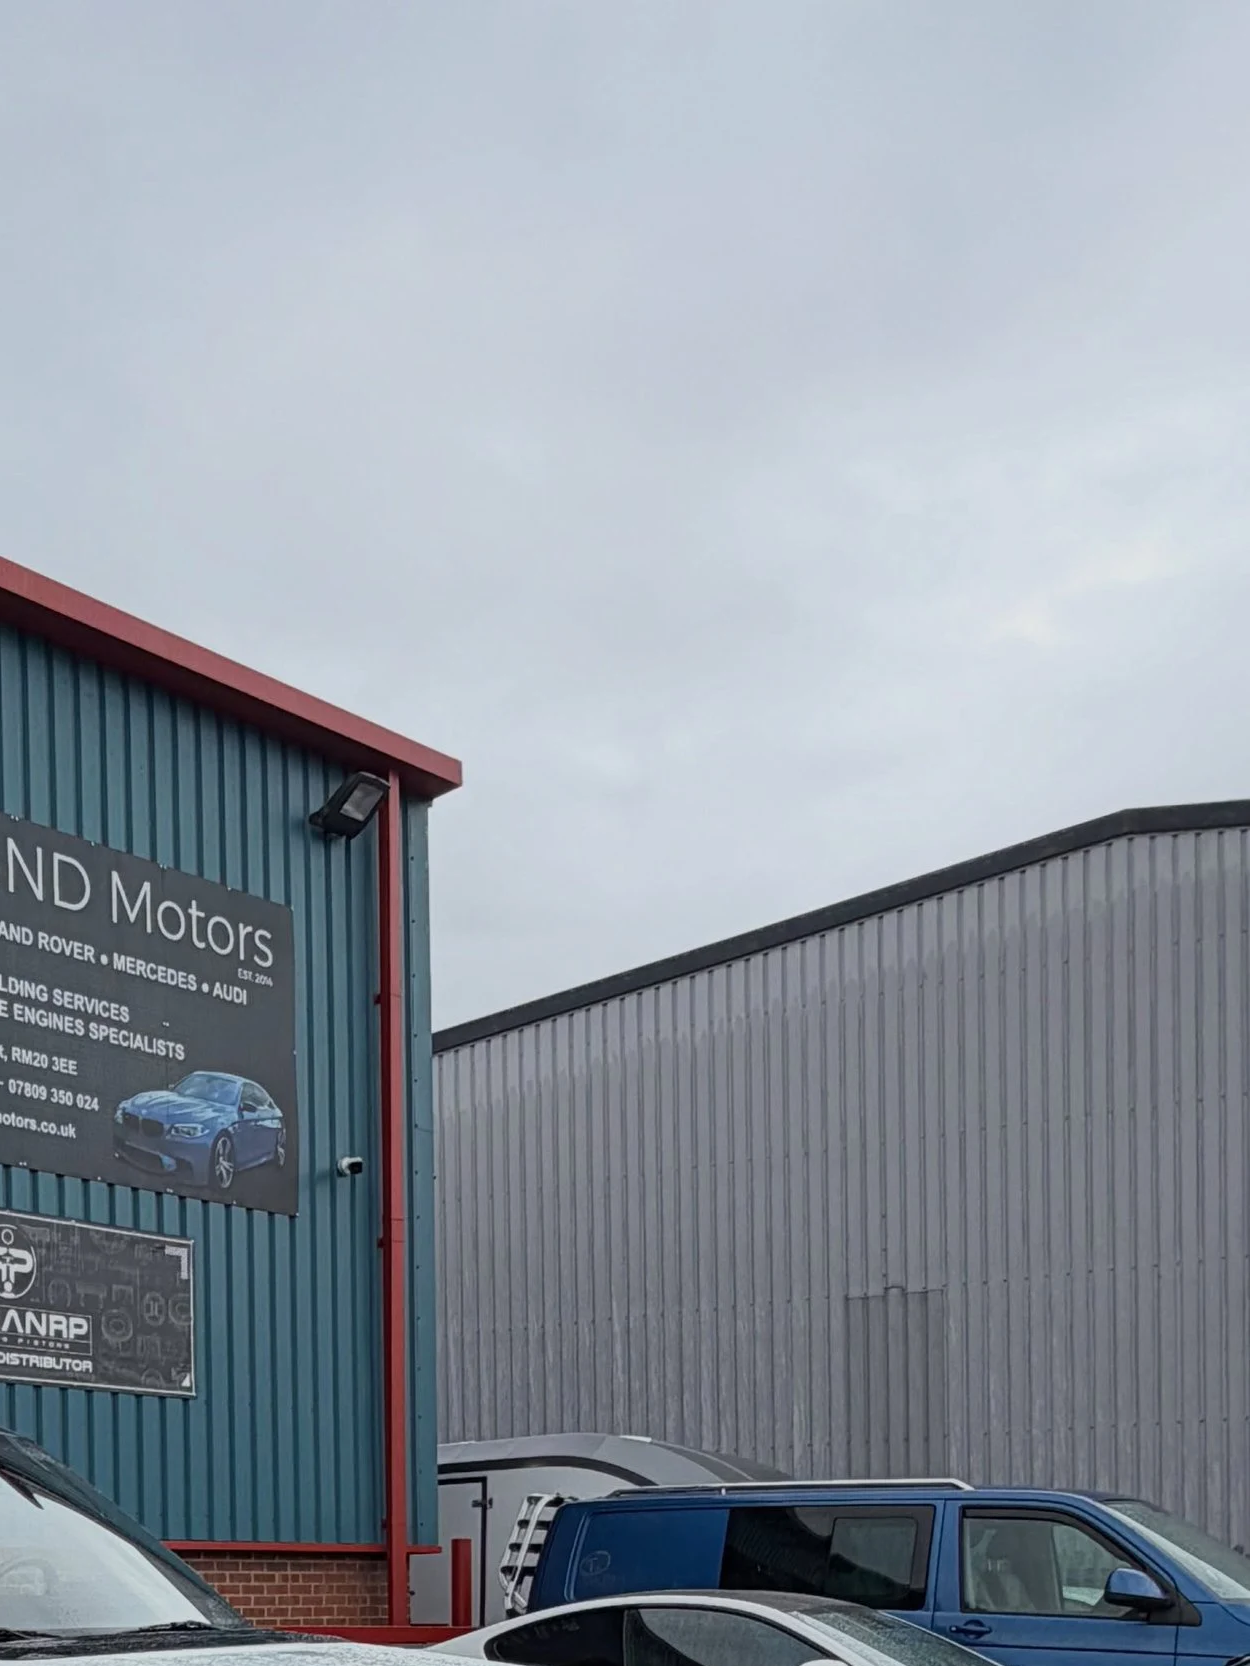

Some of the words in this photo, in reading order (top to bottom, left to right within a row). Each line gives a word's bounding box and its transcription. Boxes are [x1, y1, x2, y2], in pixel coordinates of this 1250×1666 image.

[111, 871, 274, 967] Motors
[38, 932, 96, 964] ROVER
[113, 953, 197, 991] MERCEDES
[212, 982, 247, 1005] AUDI
[52, 988, 130, 1023] SERVICES
[13, 1003, 85, 1036] ENGINES
[89, 1022, 185, 1061] SPECIALISTS
[11, 1046, 48, 1069] RM20
[51, 1056, 78, 1076] 3EE
[8, 1078, 47, 1100] 07809
[50, 1088, 73, 1106] 350
[76, 1095, 99, 1111] 024
